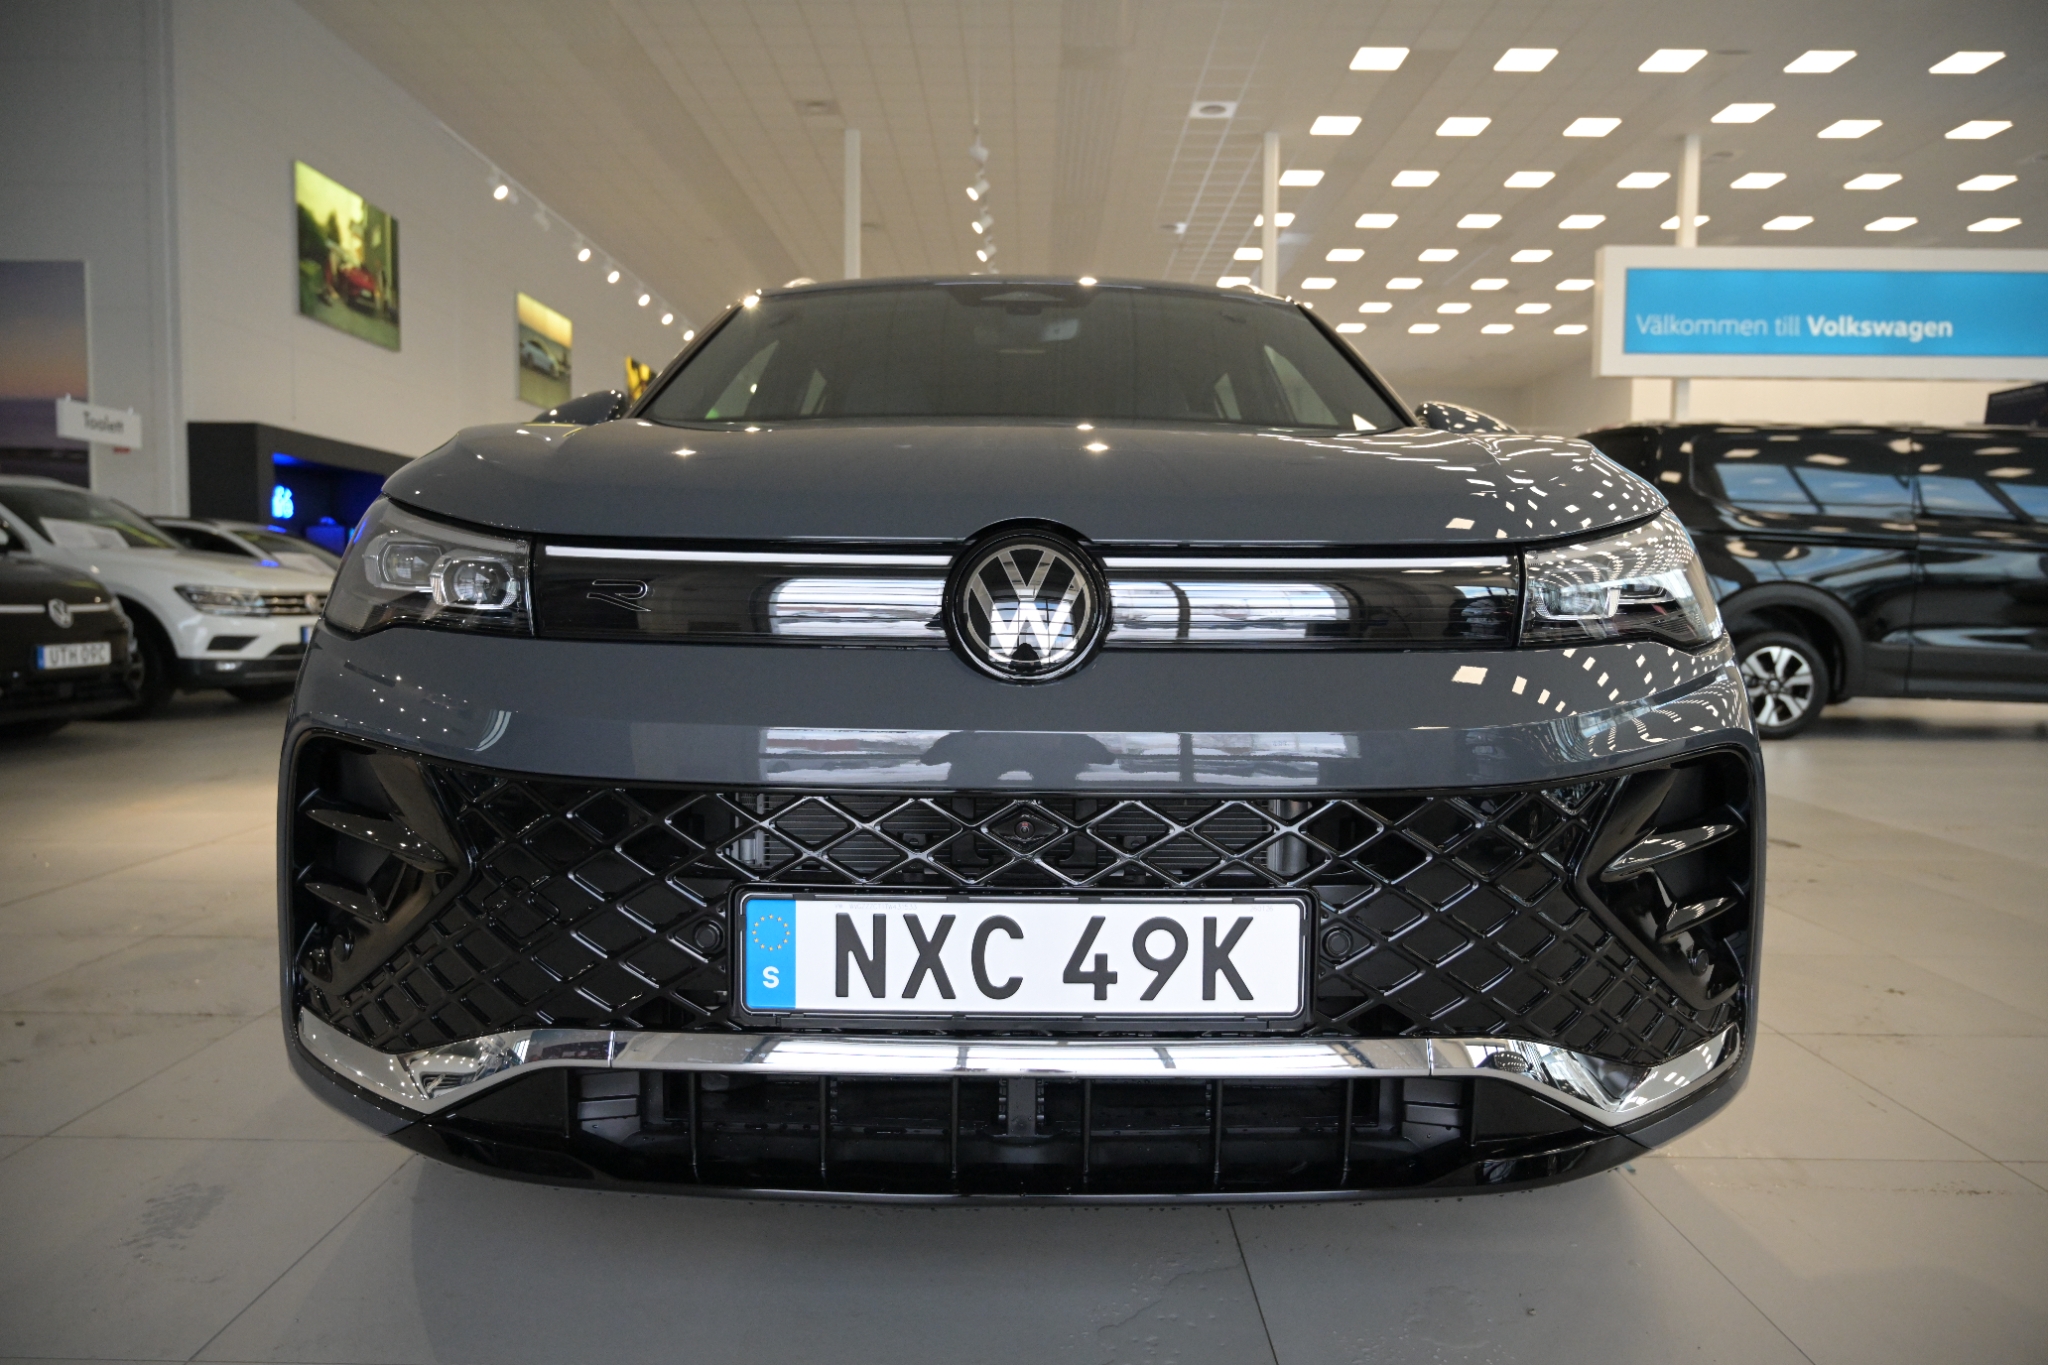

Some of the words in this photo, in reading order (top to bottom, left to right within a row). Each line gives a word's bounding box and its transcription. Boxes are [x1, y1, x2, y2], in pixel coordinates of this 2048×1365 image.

[1636, 313, 1768, 337] Välkommen
[1775, 314, 1800, 337] till
[1806, 315, 1954, 342] Volkswagen
[835, 913, 1025, 1000] NXC
[1062, 915, 1255, 1001] 49K
[762, 966, 780, 988] S
